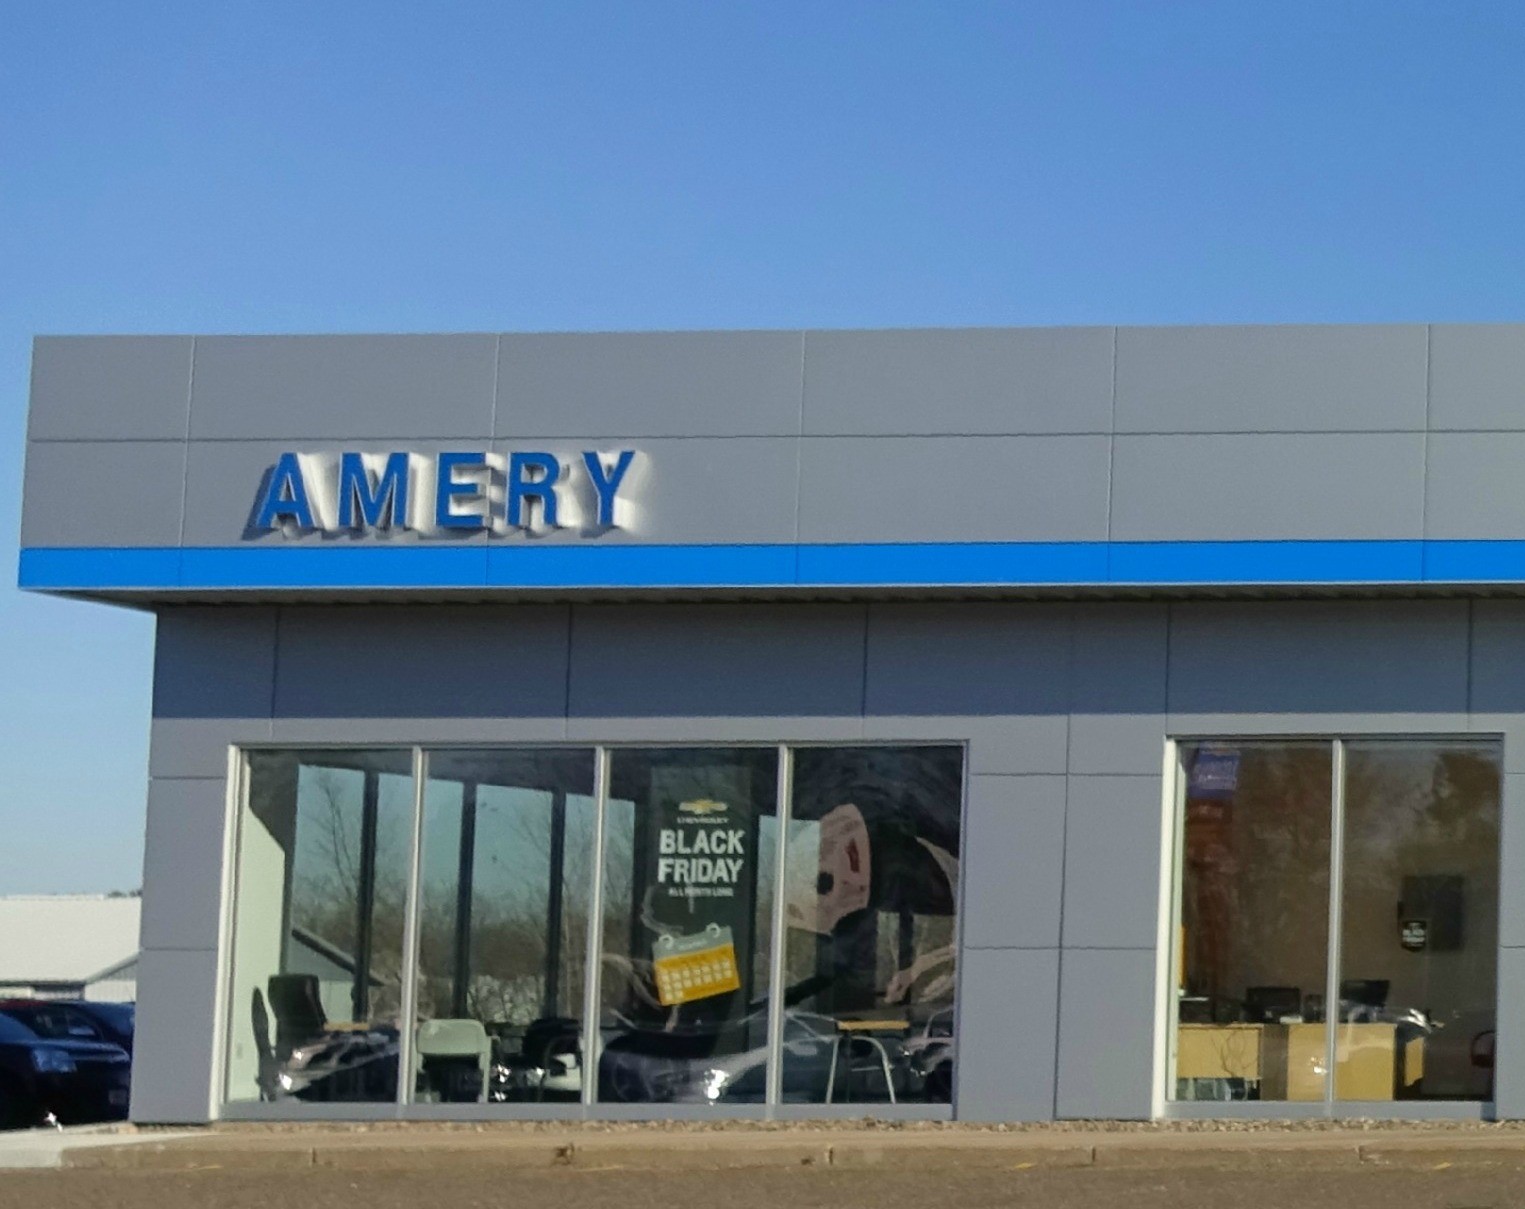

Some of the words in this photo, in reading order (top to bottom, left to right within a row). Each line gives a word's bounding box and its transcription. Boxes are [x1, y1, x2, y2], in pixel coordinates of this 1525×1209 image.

[255, 451, 637, 530] AMERY
[660, 829, 745, 854] BLACK
[658, 858, 744, 883] FRIDAY
